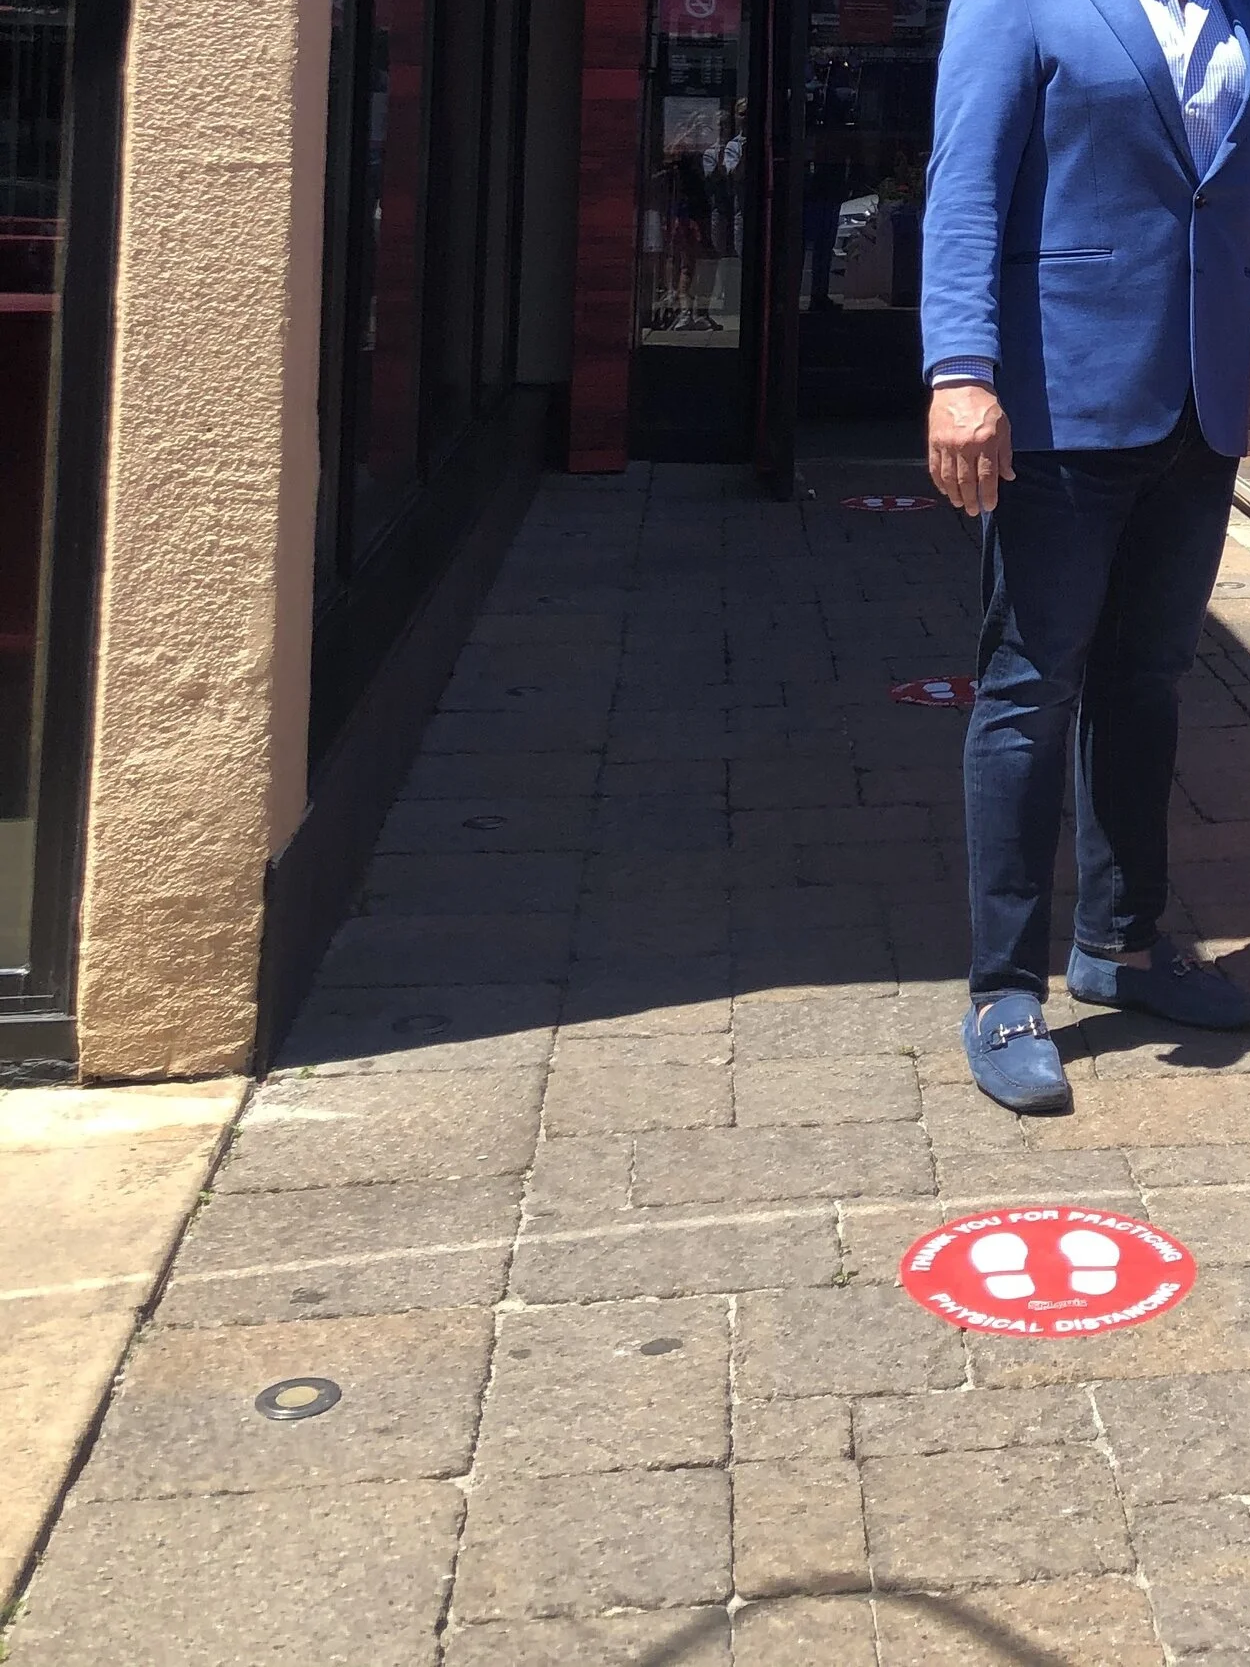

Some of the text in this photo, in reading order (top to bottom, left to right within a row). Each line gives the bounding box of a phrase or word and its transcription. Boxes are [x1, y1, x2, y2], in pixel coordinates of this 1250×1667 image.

[910, 1210, 1184, 1272] THANK YOU FOR PRACTICING
[928, 1282, 1182, 1333] PHYSICAL DISTANCING
